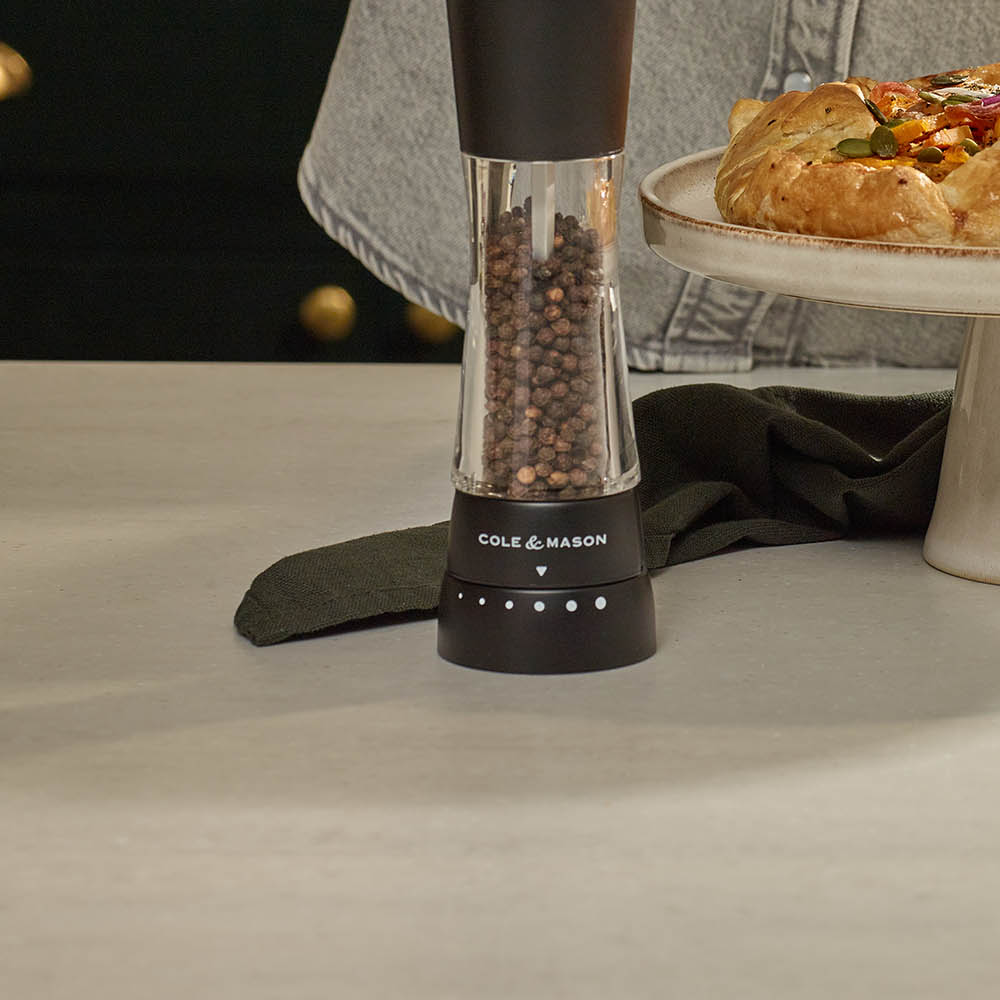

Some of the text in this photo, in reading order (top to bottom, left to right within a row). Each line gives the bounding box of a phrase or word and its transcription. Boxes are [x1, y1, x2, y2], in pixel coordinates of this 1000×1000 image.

[478, 533, 608, 550] COLE & MASON
